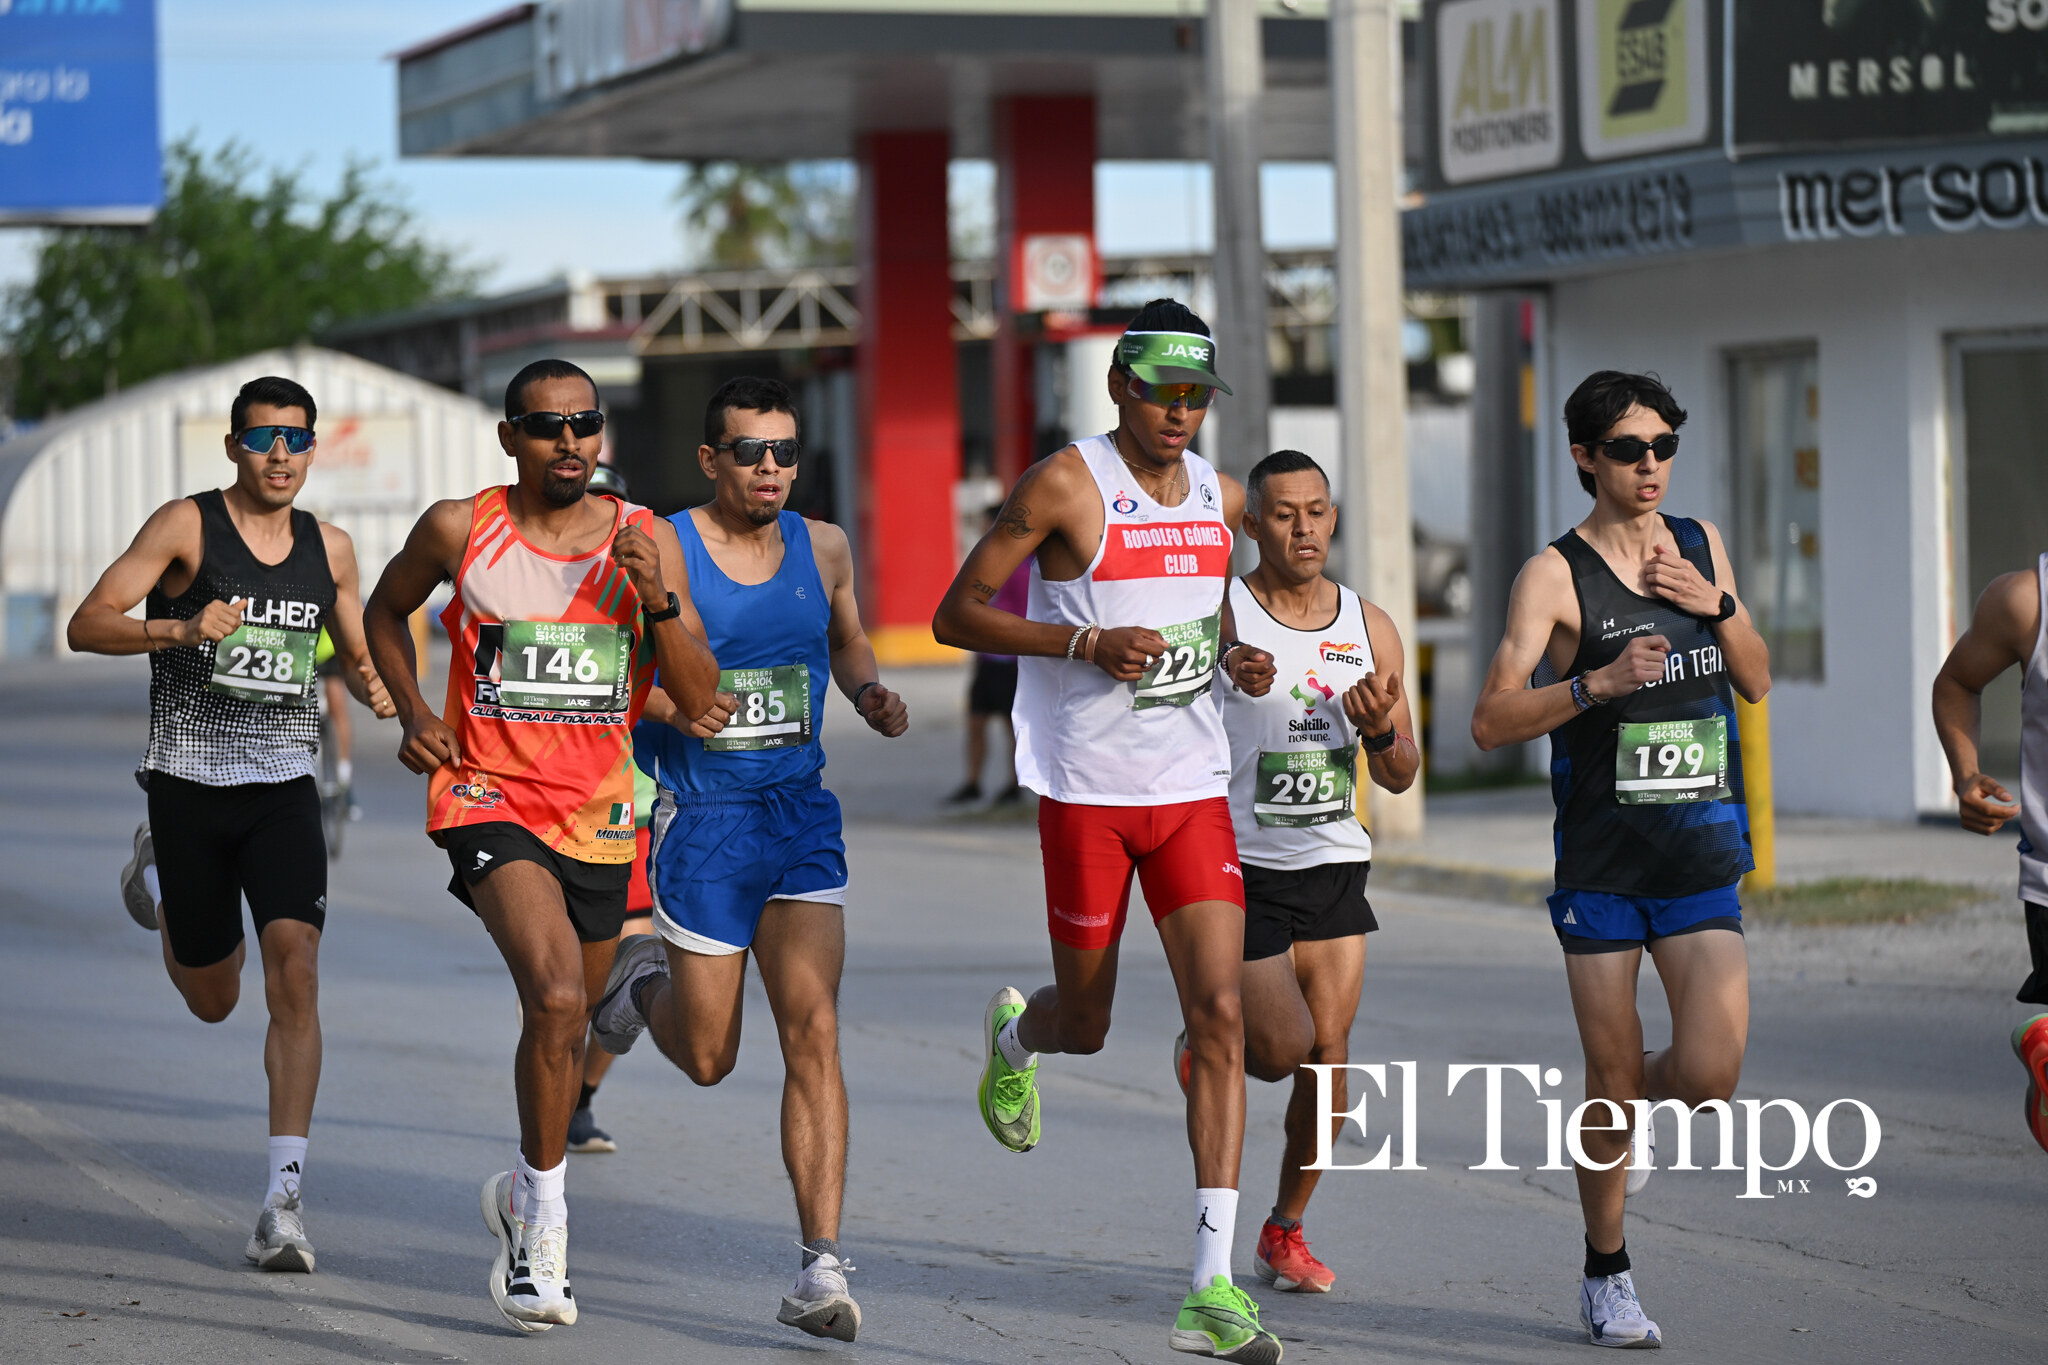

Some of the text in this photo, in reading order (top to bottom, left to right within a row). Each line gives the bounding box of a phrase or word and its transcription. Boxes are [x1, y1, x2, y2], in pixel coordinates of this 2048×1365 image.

[1452, 7, 1549, 119] ALM
[1789, 52, 1974, 99] MERSOL
[1122, 523, 1224, 549] RODOLFO GÓMEZ
[1164, 554, 1198, 575] CLUB
[246, 628, 287, 638] CARRERA
[535, 624, 586, 633] CARRERA
[619, 631, 630, 639] 146
[1161, 621, 1202, 635] CARRERA
[1601, 622, 1655, 641] ARTURO
[227, 646, 294, 682] 238
[521, 646, 599, 683] 146
[1152, 639, 1212, 686] 225
[1326, 652, 1363, 666] CROC
[302, 650, 314, 698] MEDALLA
[615, 644, 627, 699] MEDALLA
[734, 670, 773, 678] CARRERA
[502, 711, 542, 722] NORA
[543, 713, 593, 724] LETICIA
[802, 682, 810, 735] MEDALLA
[1289, 718, 1330, 732] Saltillo
[1648, 722, 1693, 731] CARRERA
[1288, 733, 1330, 743] nos une.
[1287, 752, 1327, 760] CARRERA
[1635, 743, 1704, 777] 199
[1270, 771, 1335, 803] 295
